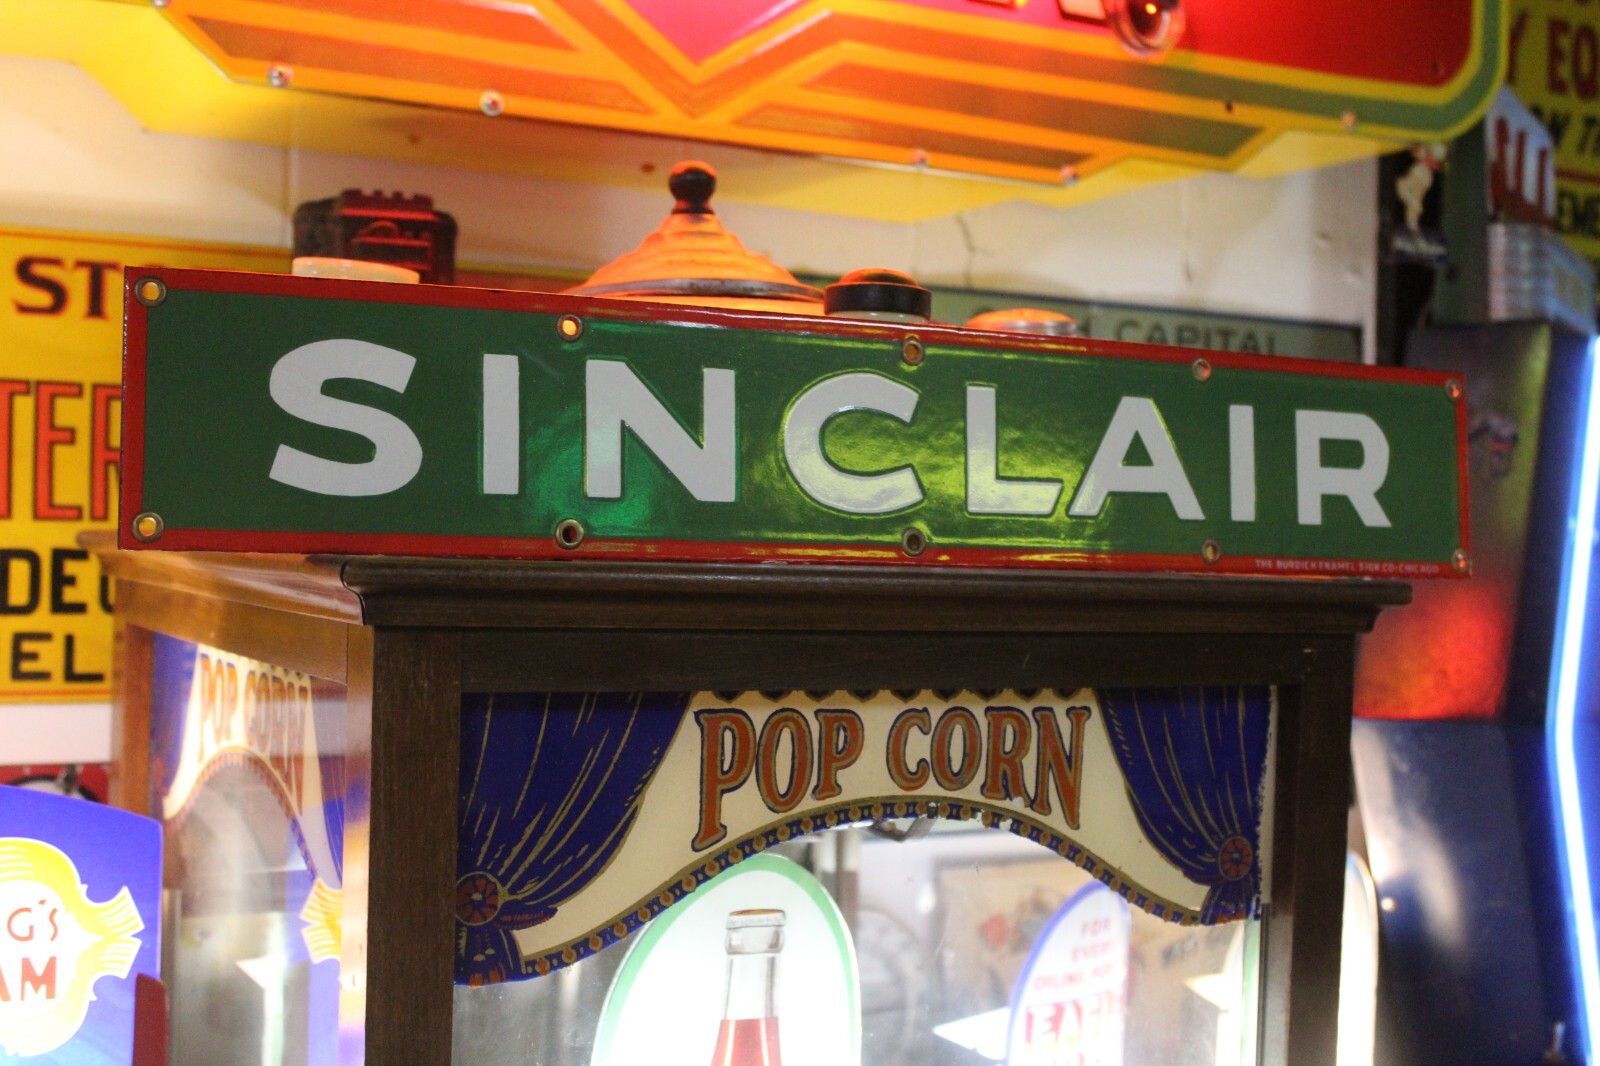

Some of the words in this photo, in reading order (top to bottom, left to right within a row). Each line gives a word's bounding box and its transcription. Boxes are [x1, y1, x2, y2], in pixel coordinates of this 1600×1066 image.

[14, 255, 123, 320] ST
[269, 338, 1392, 528] SINCLAIR
[198, 653, 238, 767] POP
[692, 706, 865, 853] POP
[886, 705, 1092, 831] CORN
